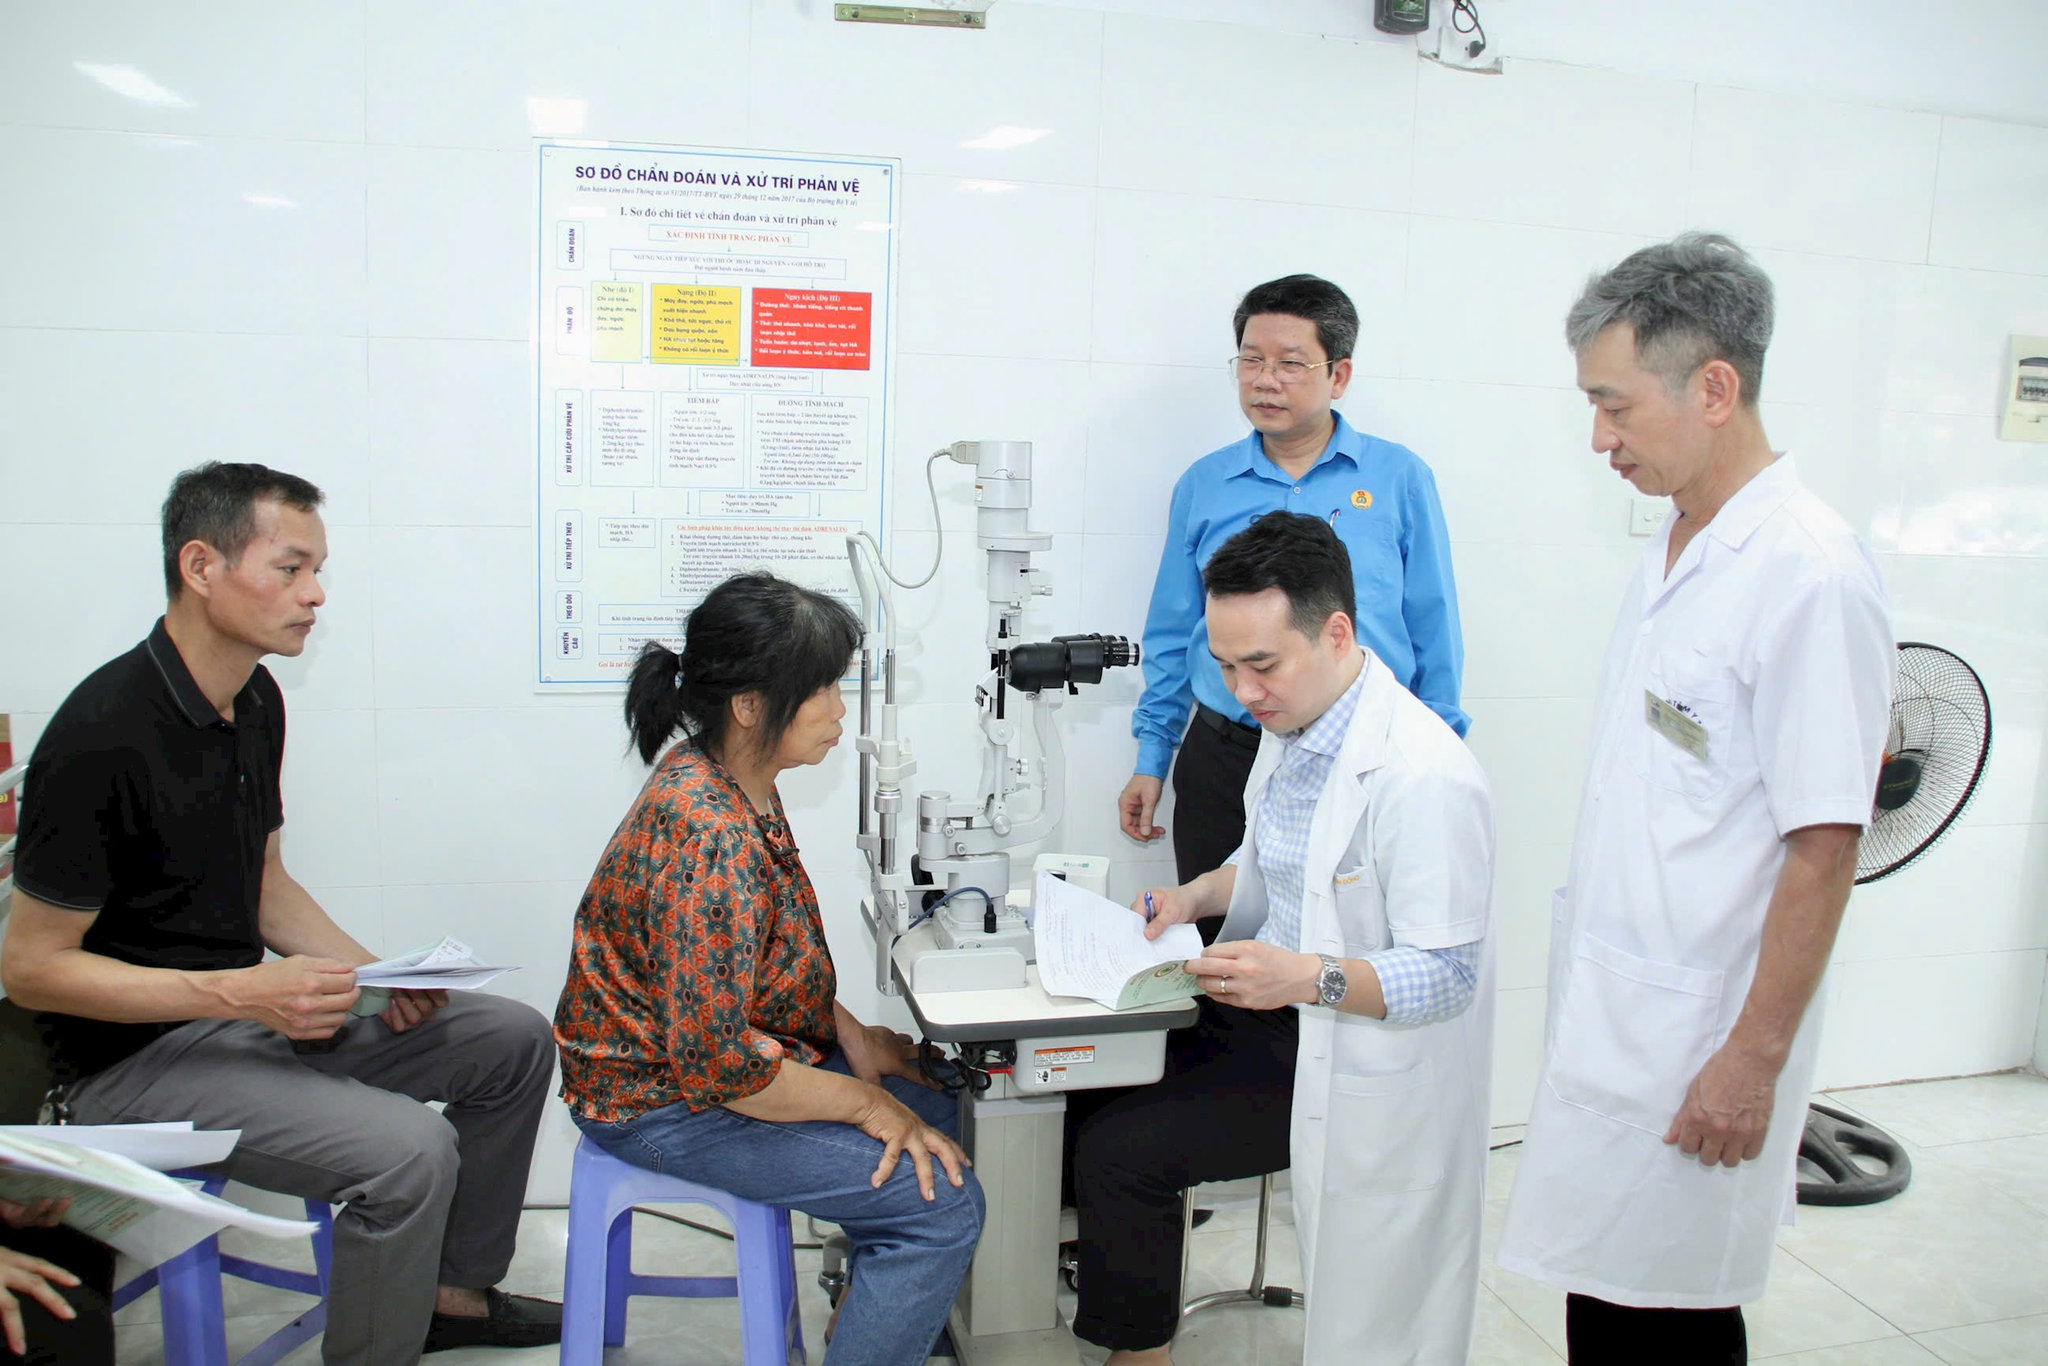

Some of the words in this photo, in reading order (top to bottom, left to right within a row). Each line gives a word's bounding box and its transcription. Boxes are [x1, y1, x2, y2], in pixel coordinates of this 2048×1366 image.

[575, 166, 596, 179] SƠ
[600, 163, 622, 180] ĐỒ
[627, 162, 669, 182] CHẨN
[673, 169, 716, 185] ĐOÁN
[721, 171, 741, 186] VÀ
[746, 171, 768, 187] XỬ
[771, 174, 793, 189] TRÍ
[798, 175, 838, 192] PHẢN
[841, 178, 860, 196] VỆ
[620, 206, 627, 216] I.
[630, 207, 642, 216] Sơ
[732, 211, 756, 222] đoán
[562, 632, 570, 655] KHUYẾN
